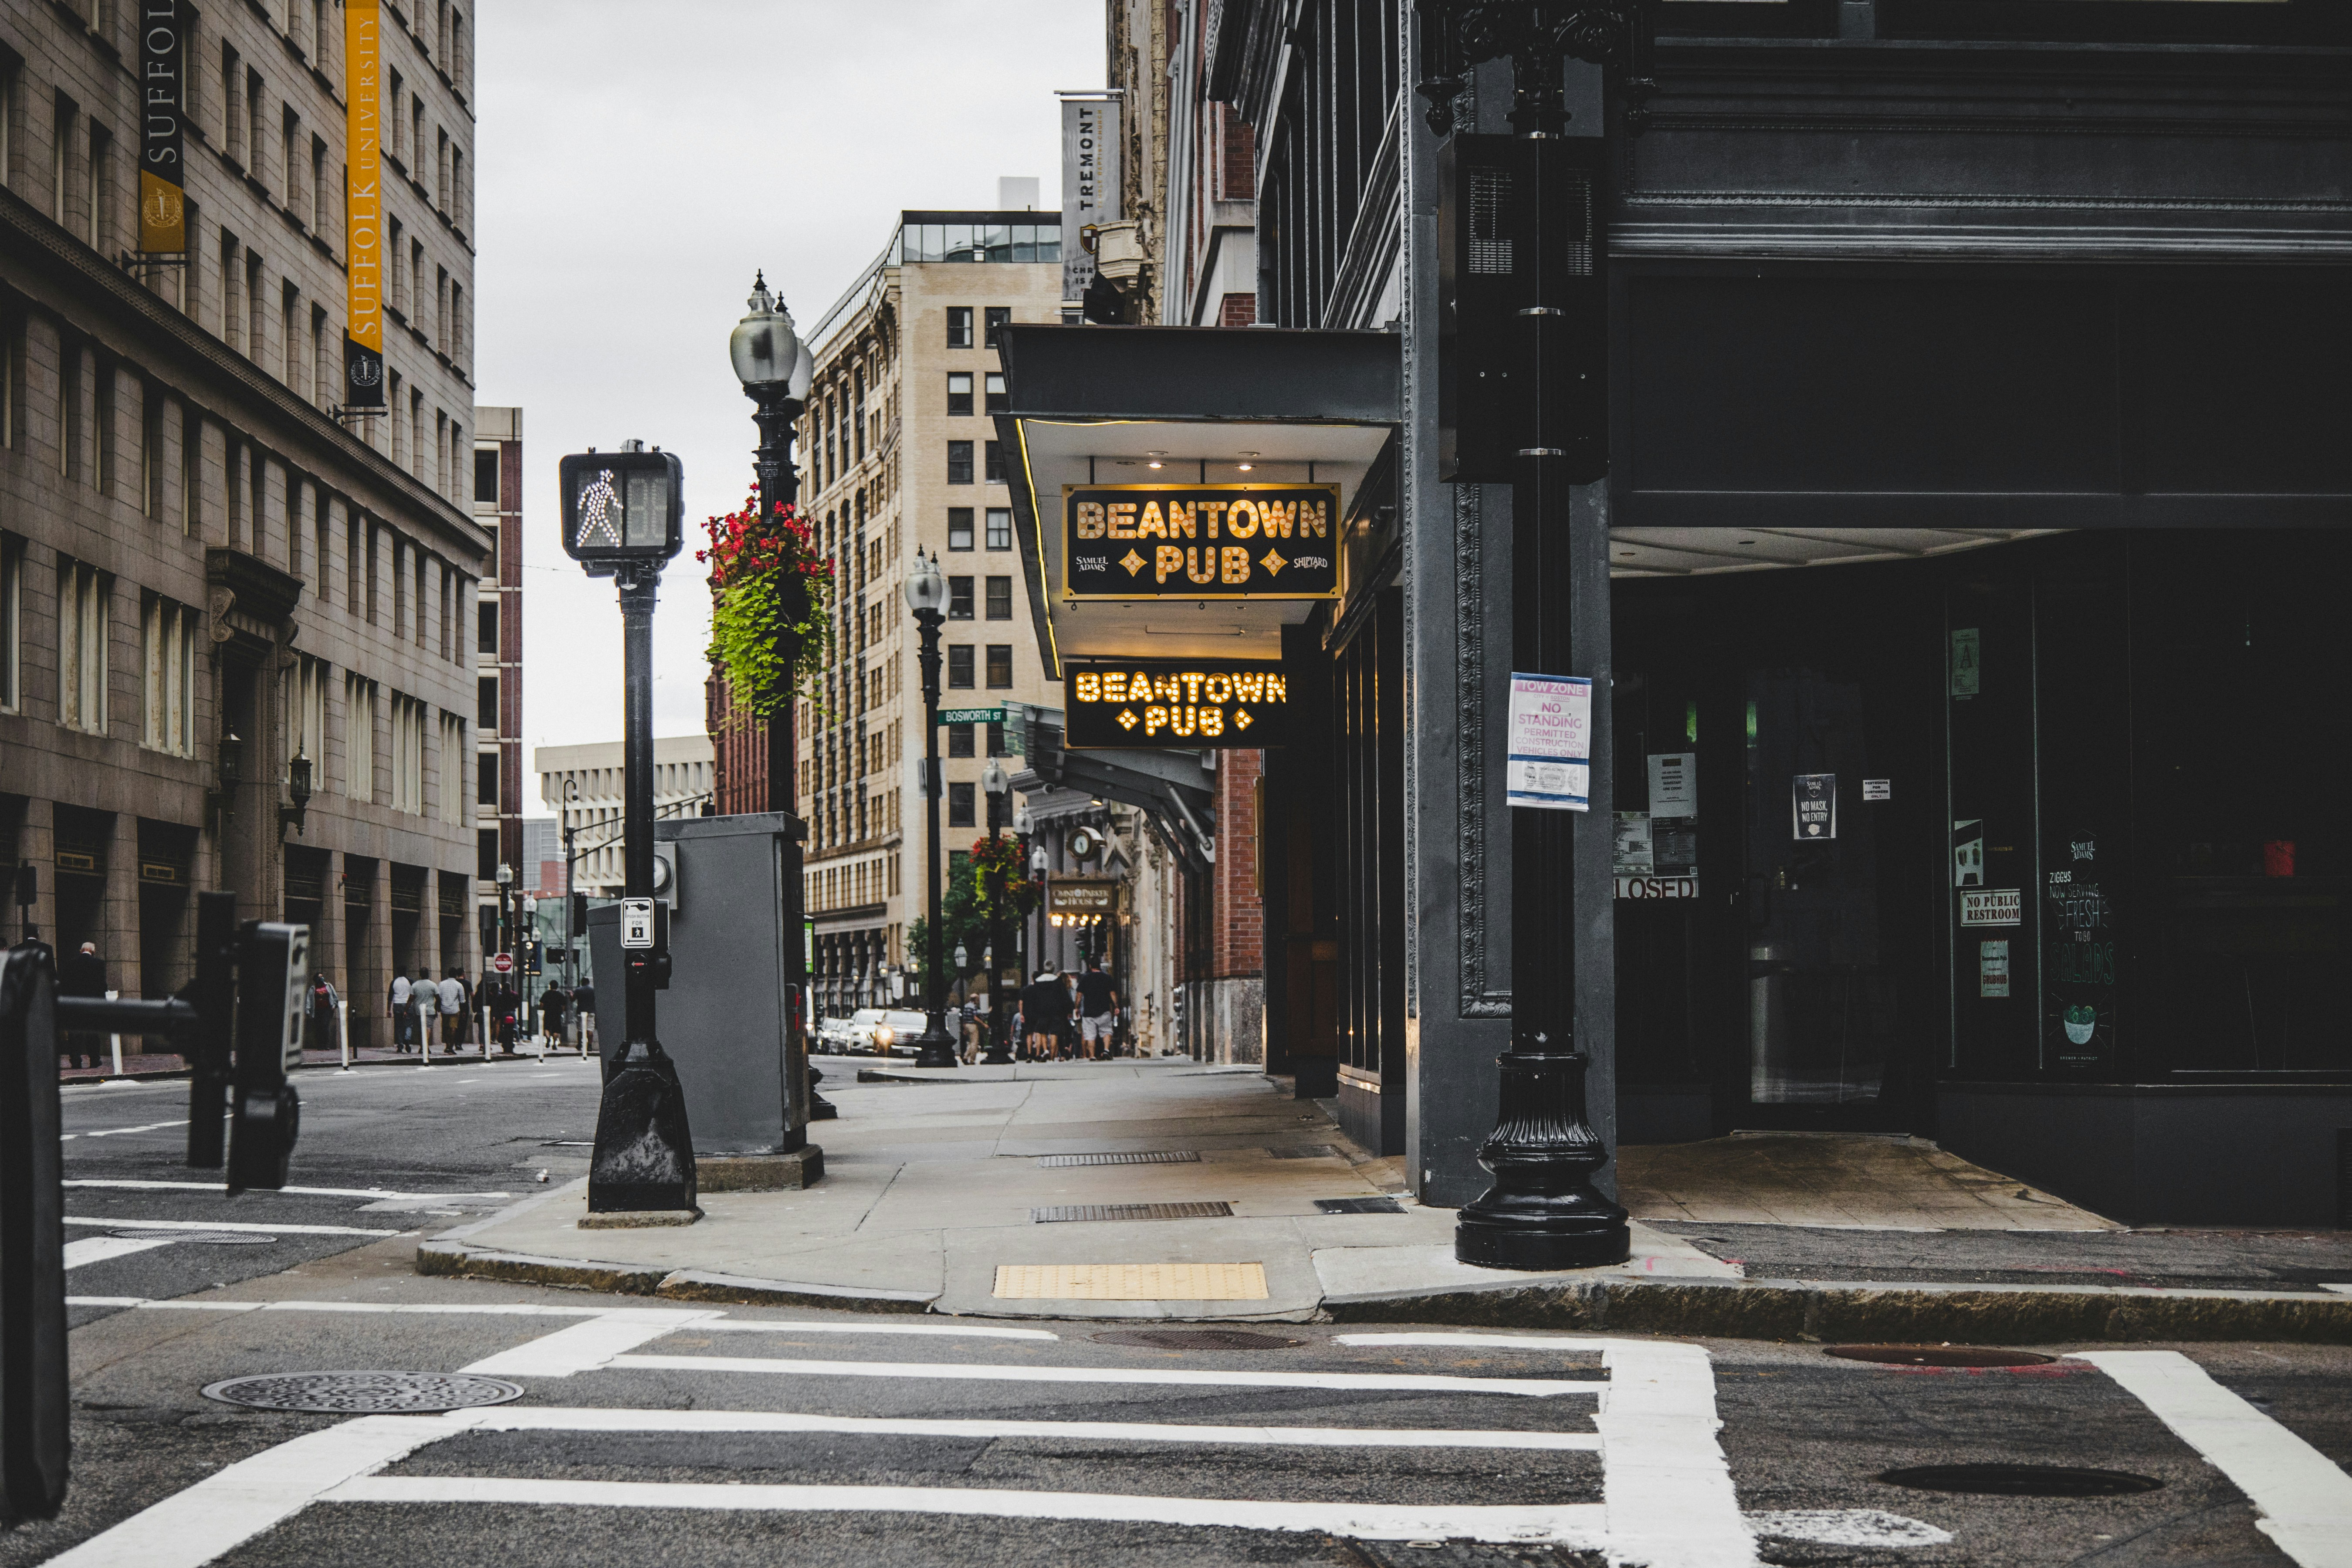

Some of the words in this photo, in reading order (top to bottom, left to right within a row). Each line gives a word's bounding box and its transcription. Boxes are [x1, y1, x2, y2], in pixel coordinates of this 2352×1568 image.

[147, 0, 176, 163] SUFFOL
[359, 17, 375, 169] UNIVERSITY
[1080, 108, 1093, 210] TREMONT
[353, 181, 376, 335] SUFFOLK
[1077, 500, 1327, 539] BEANTOWN
[1076, 556, 1109, 565] SAMUEL
[1156, 545, 1250, 584] PUB
[1293, 556, 1328, 568] SHIPYARD
[1079, 564, 1106, 572] ADAMS
[1076, 671, 1286, 704] BEANTOWN
[1520, 680, 1549, 692] TOW
[1550, 682, 1583, 695] ZONE
[1542, 702, 1561, 713] NO
[946, 710, 991, 722] BOSWORTH
[993, 711, 1002, 720] ST
[1145, 705, 1225, 737] PUB
[1518, 714, 1582, 729] STANDING
[1524, 728, 1576, 739] PERMITTED
[1516, 736, 1584, 749] CONSTRUCTION
[1517, 745, 1558, 756] VEHICLES
[1560, 749, 1582, 758] ONLY
[1801, 801, 1810, 812] NO
[1810, 800, 1827, 812] MASK,
[1802, 813, 1810, 822] NO
[1811, 812, 1827, 822] ENTRY
[2071, 841, 2095, 853] SAMUEL
[2072, 850, 2093, 861] ADAMS
[2049, 870, 2071, 884] ZIGGYS
[1613, 877, 1694, 899] LOSED
[2049, 885, 2065, 899] NOW
[1967, 897, 1980, 907] NO
[1984, 895, 2020, 907] PUBLIC
[1967, 908, 2020, 920] RESTROOM
[2066, 899, 2099, 928] FRESH
[2049, 941, 2115, 985] SALADS
[1983, 974, 2007, 985] GRUBHUB
